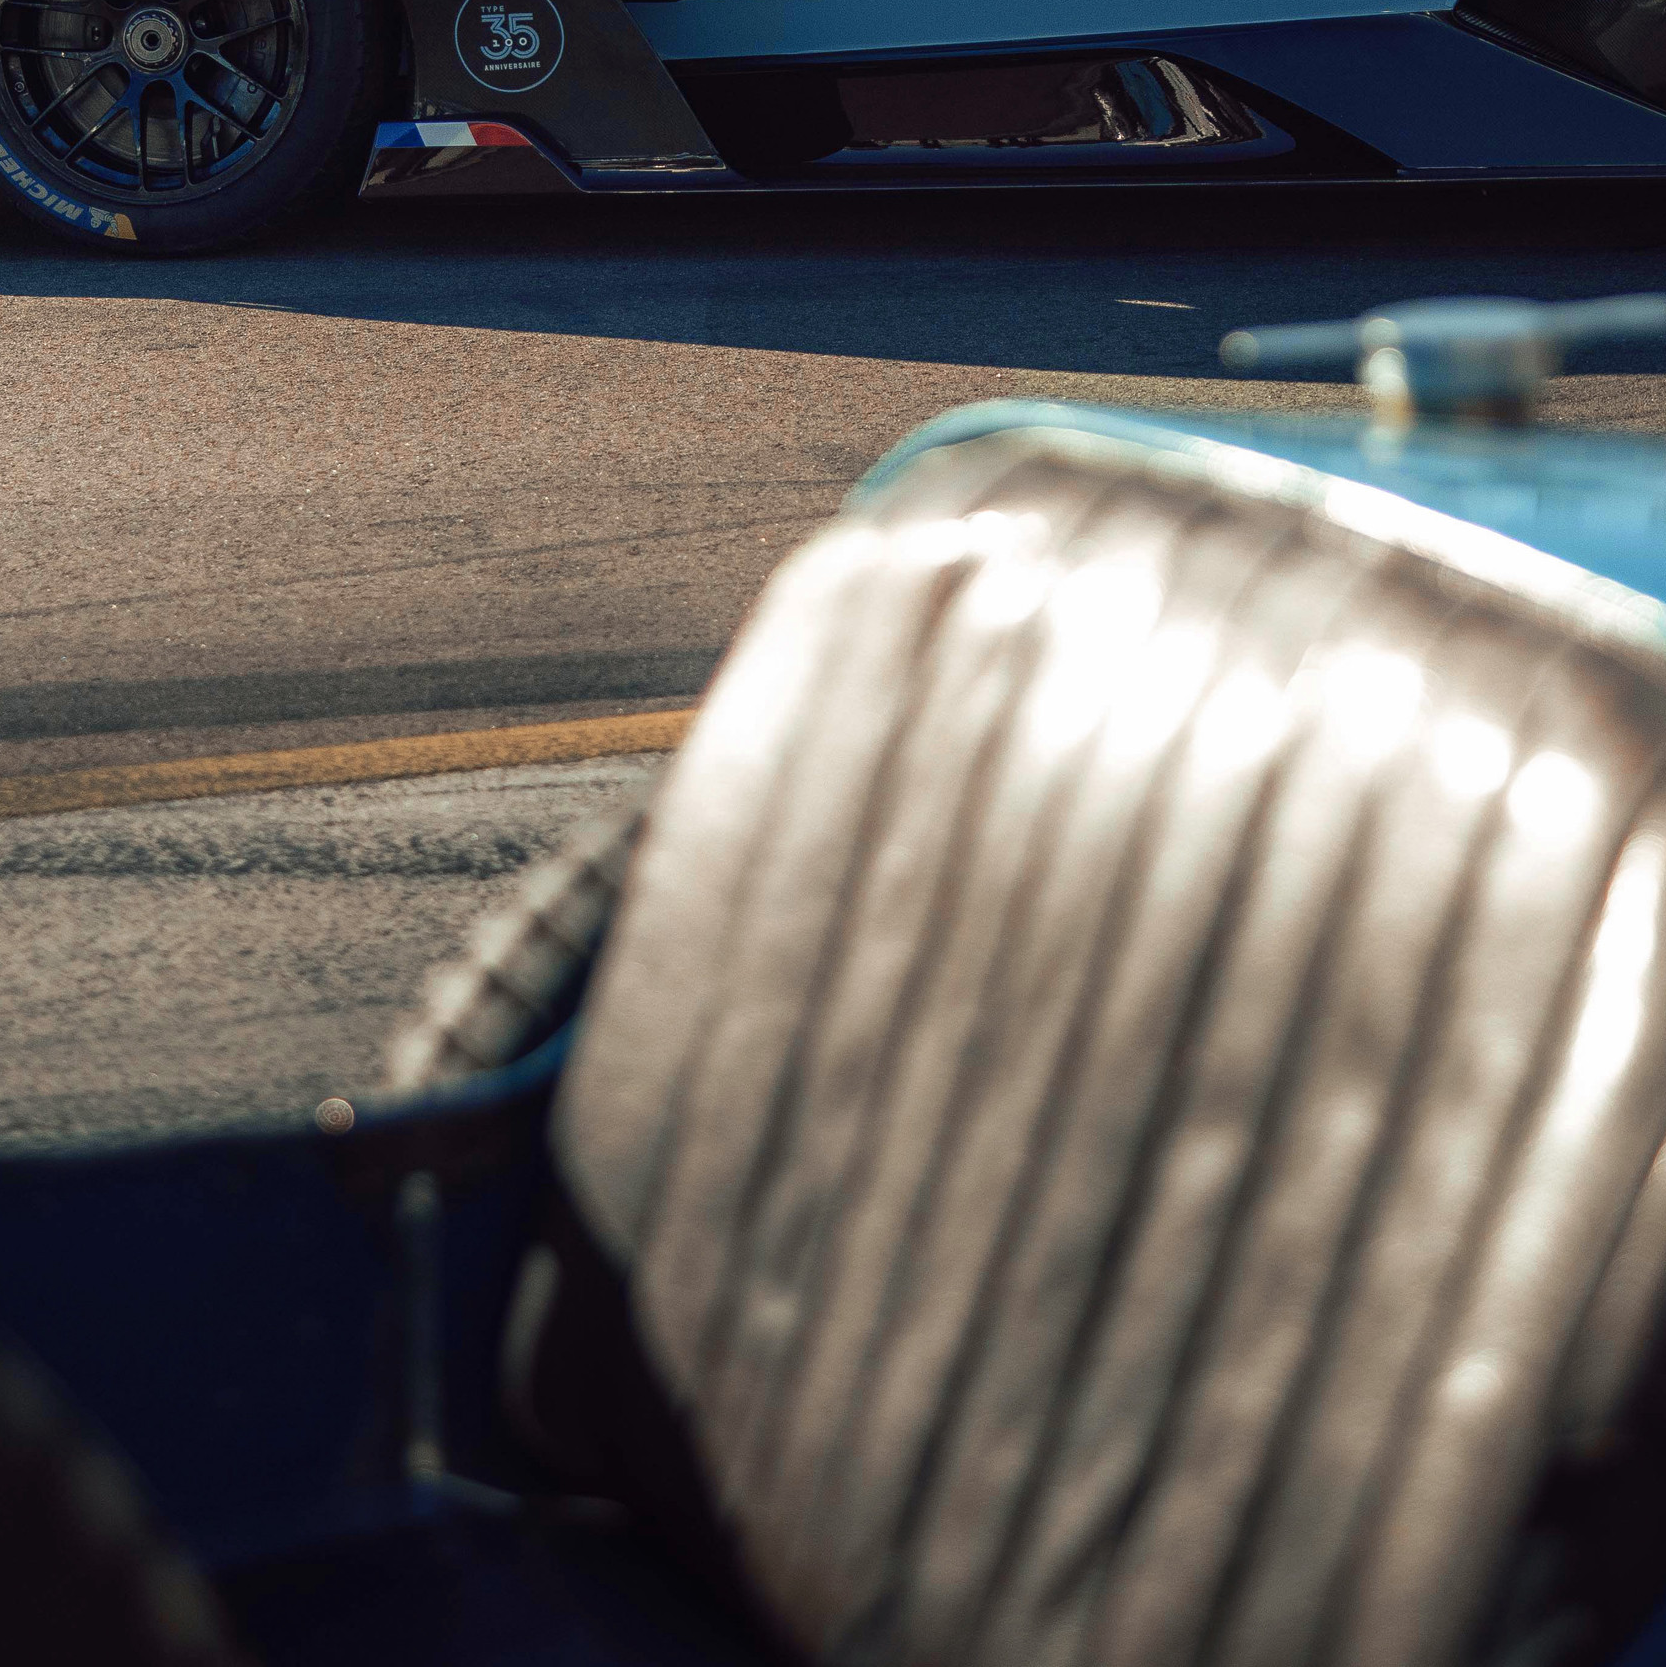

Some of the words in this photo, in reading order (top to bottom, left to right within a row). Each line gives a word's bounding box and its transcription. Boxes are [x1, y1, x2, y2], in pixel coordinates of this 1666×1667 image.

[480, 12, 541, 60] 35
[492, 37, 528, 48] 100
[484, 61, 541, 71] ANNIVERSAIRE
